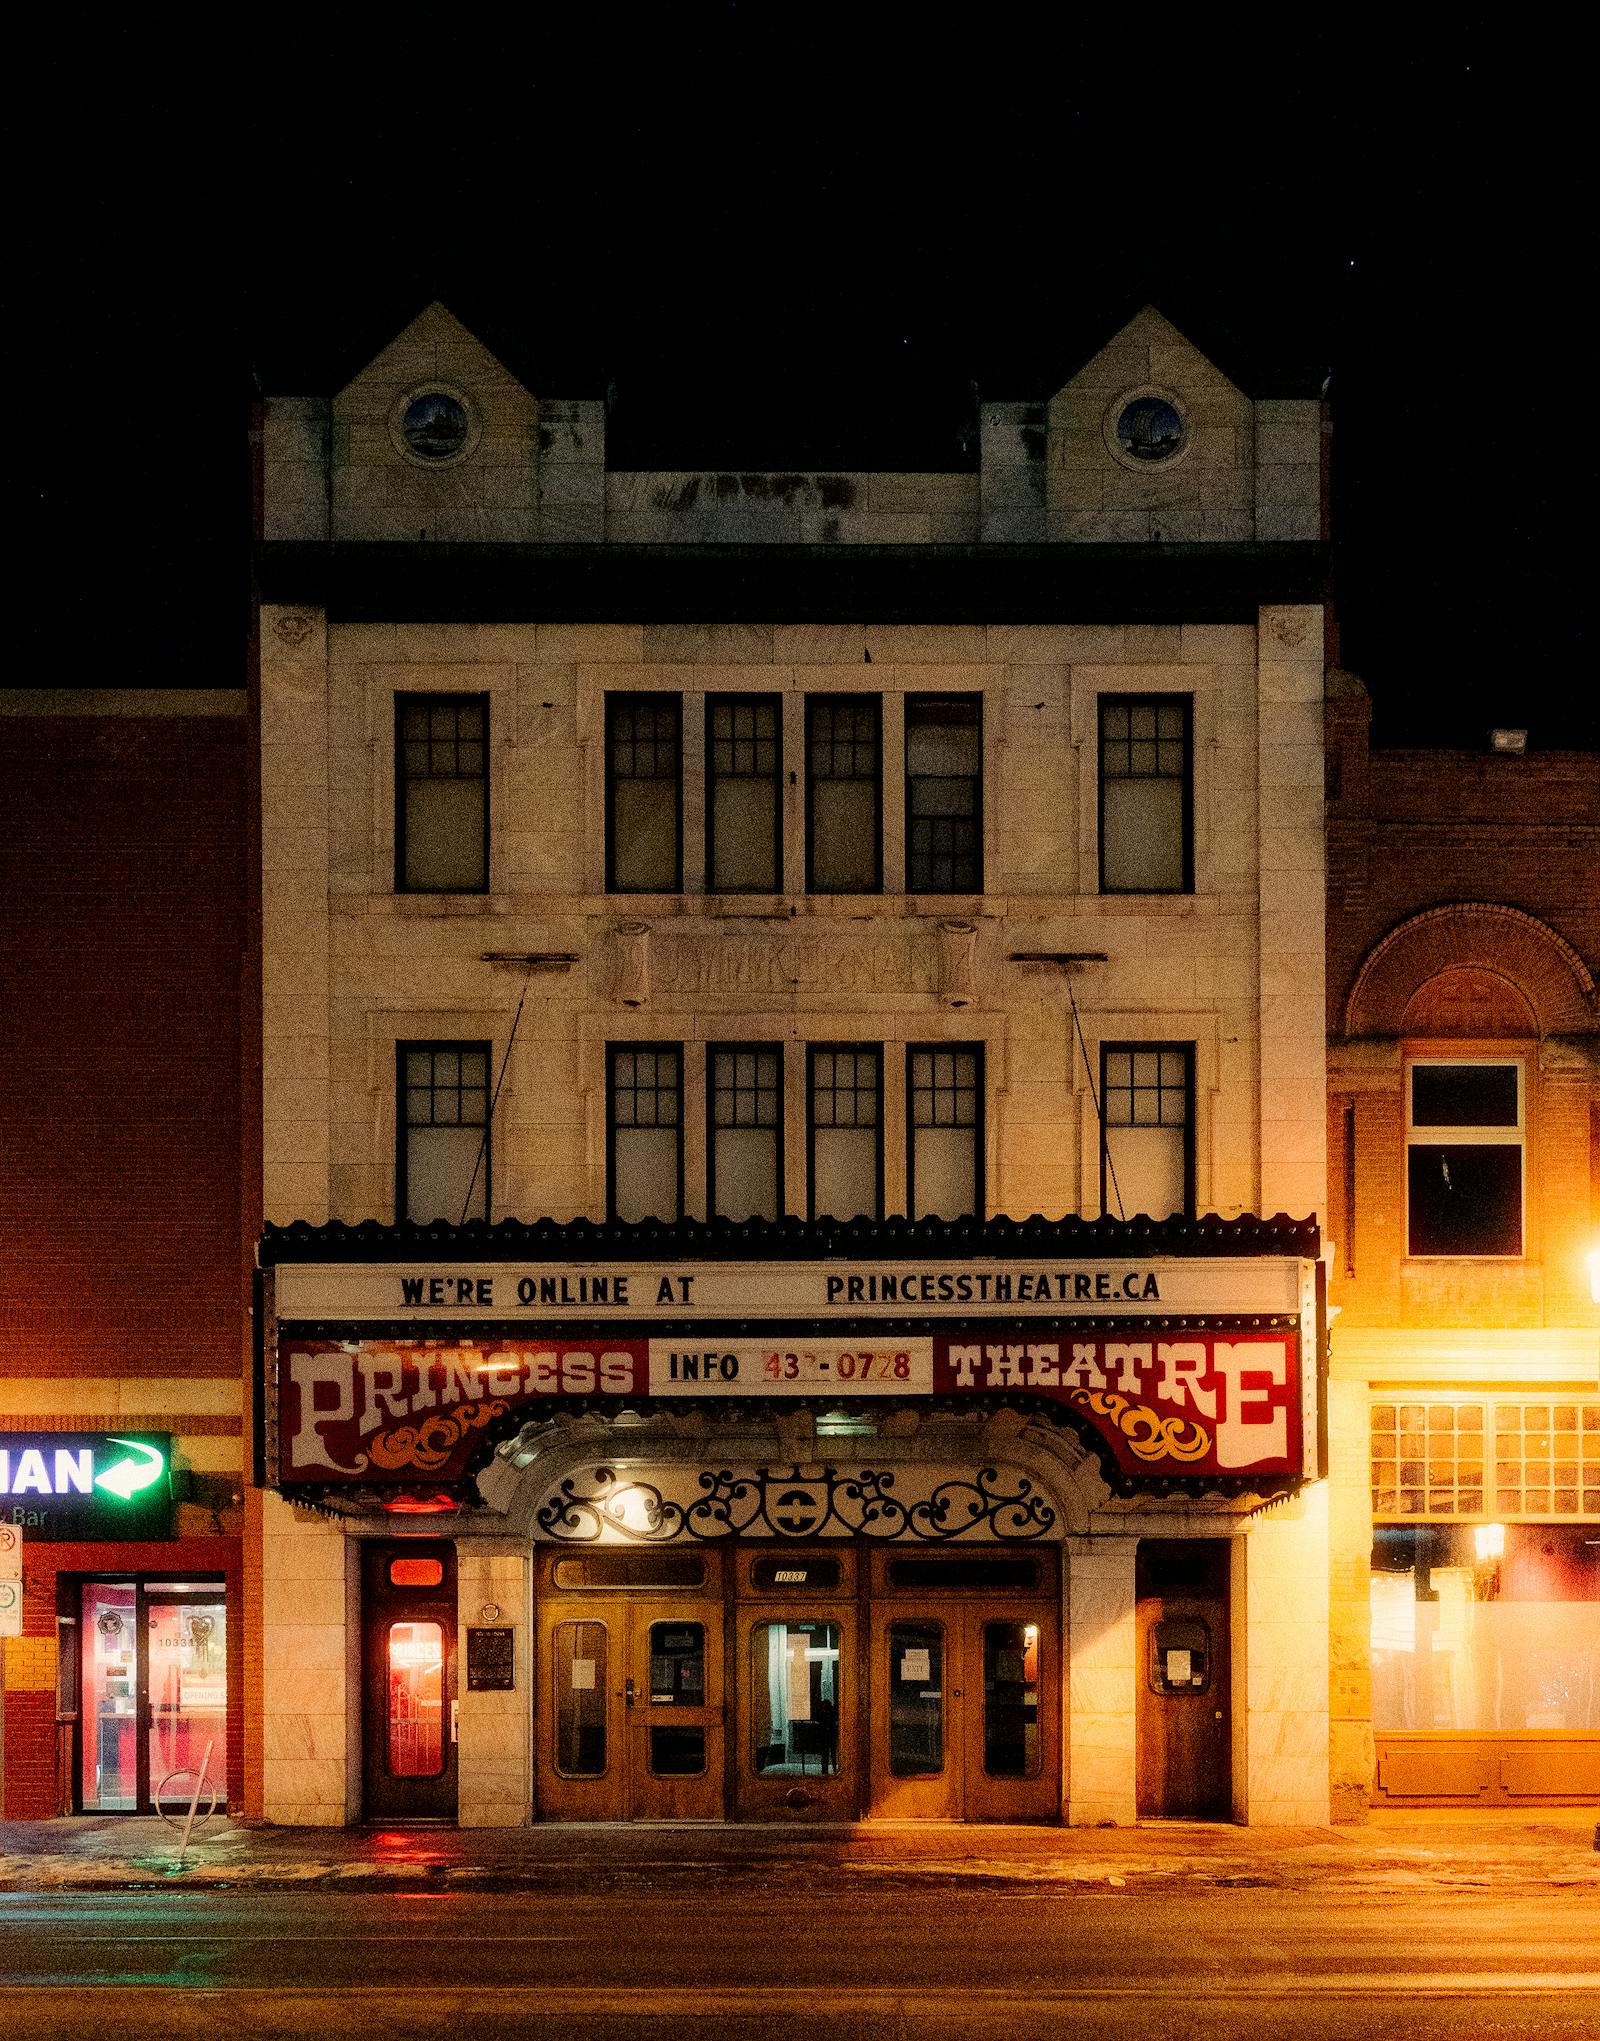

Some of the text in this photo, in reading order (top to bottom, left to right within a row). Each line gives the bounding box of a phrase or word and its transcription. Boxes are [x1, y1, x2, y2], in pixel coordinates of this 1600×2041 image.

[401, 1273, 1159, 1304] WE'RE ONLINE AT PRINCESSTHEATRE.CA
[670, 1353, 738, 1381] INFO
[290, 1351, 635, 1475] PRINCESS
[948, 1342, 1288, 1468] THEATRE
[13, 1506, 48, 1526] Bar
[777, 1572, 806, 1581] 10337
